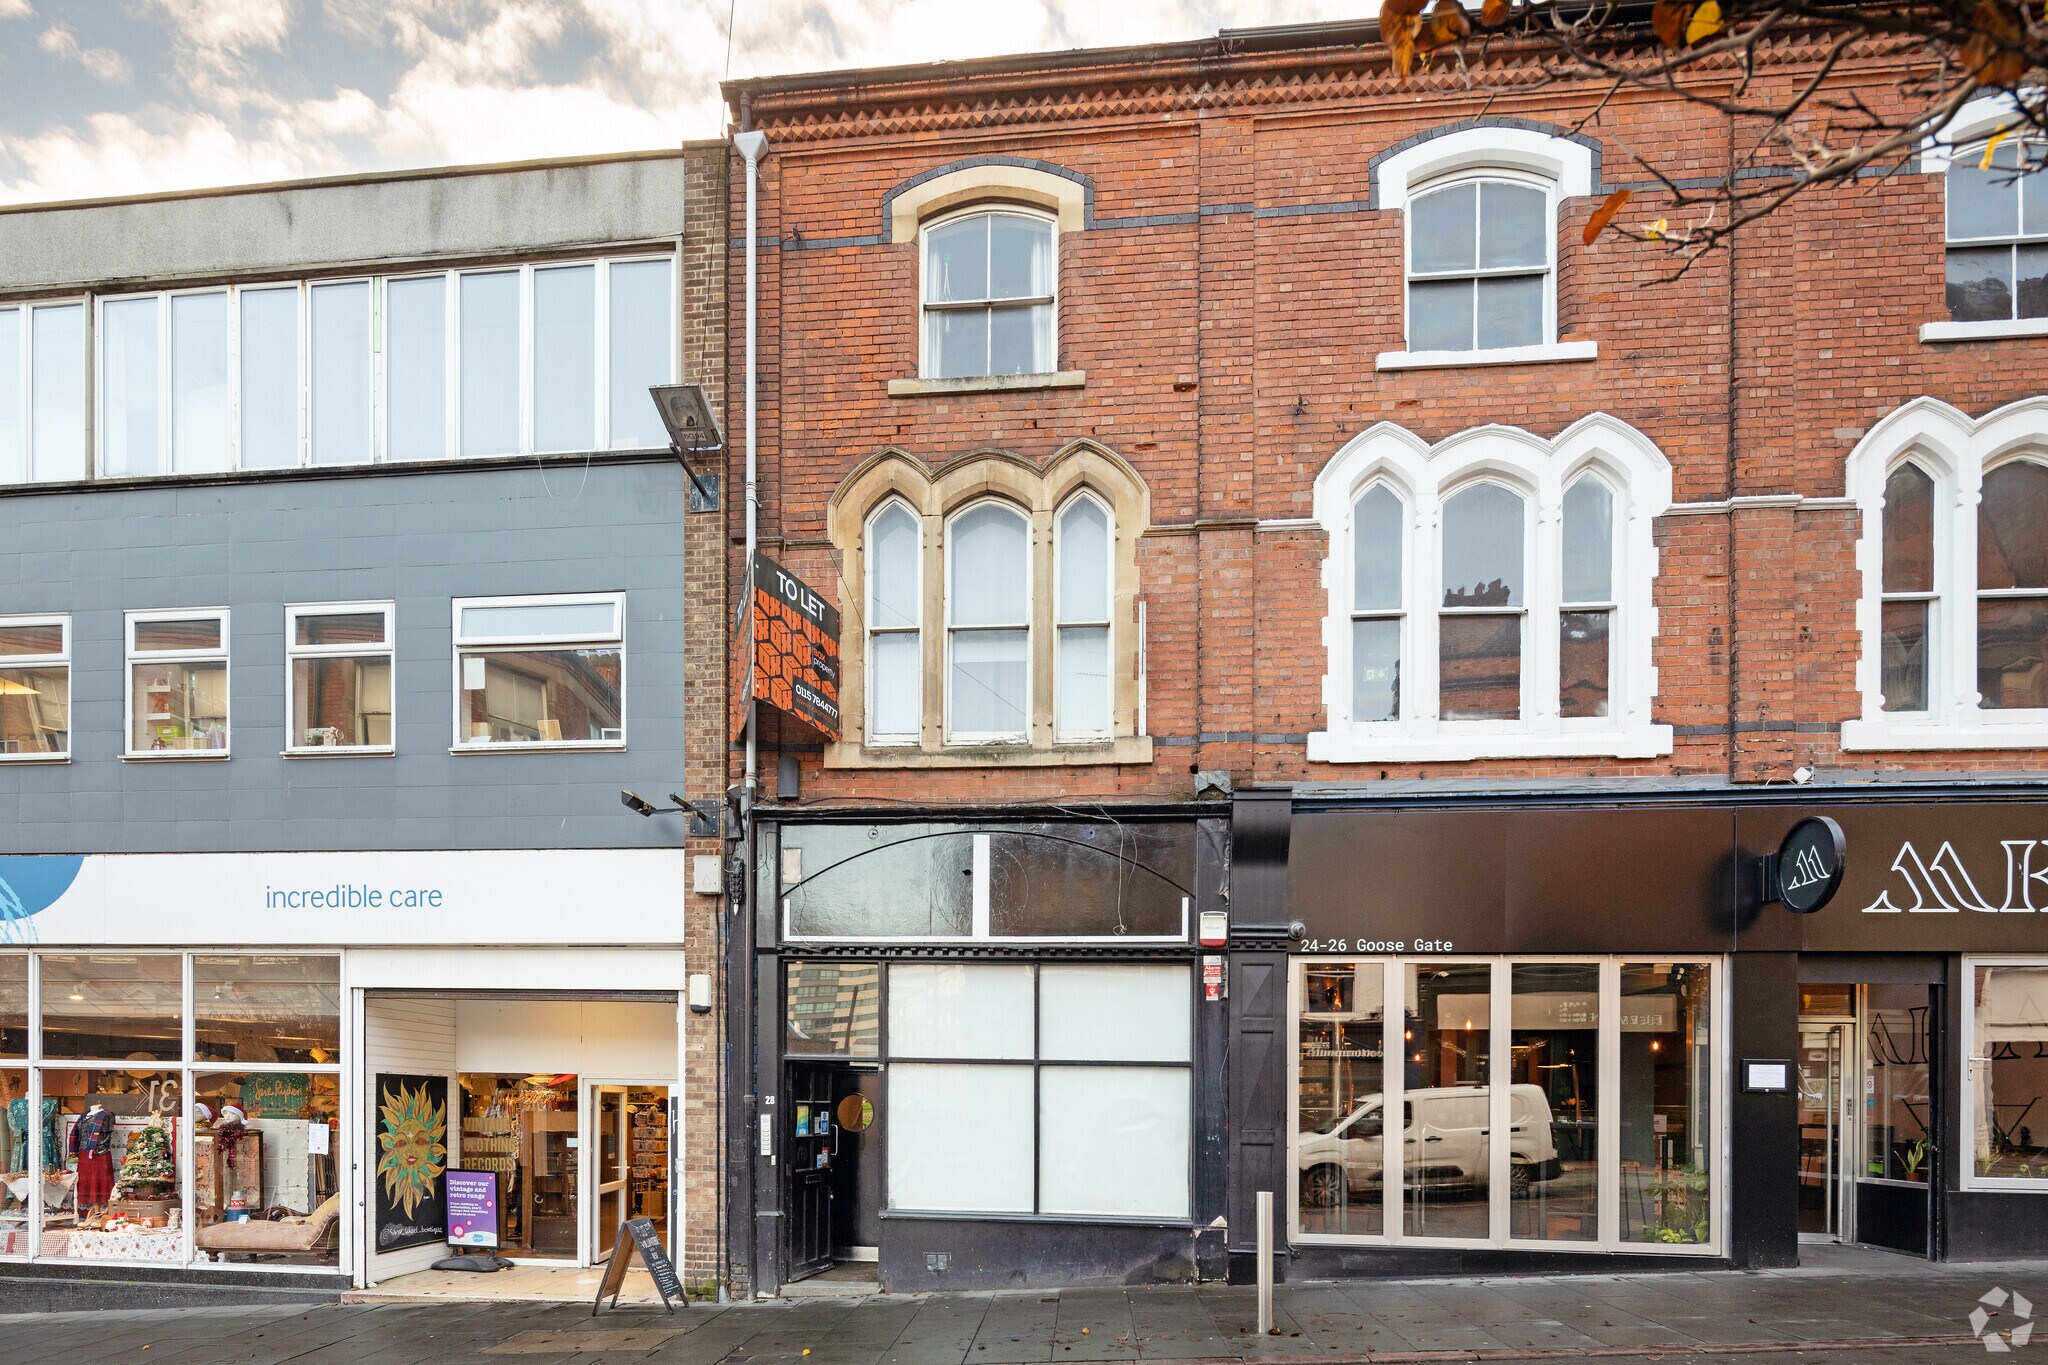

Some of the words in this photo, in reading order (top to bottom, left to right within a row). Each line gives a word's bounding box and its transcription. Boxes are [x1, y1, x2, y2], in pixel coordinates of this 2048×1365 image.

[776, 571, 798, 601] TO
[800, 587, 826, 621] LET
[813, 657, 836, 679] property
[795, 684, 812, 701] 0115
[812, 693, 839, 719] 7844777
[266, 884, 383, 909] incredible
[389, 889, 443, 908] care
[1300, 939, 1347, 952] 24-26
[1356, 938, 1405, 952] Goose
[1413, 938, 1453, 952] Gate
[274, 1079, 300, 1103] Ryder
[765, 1095, 775, 1105] 28
[464, 1117, 511, 1132] VINTAGE
[464, 1138, 516, 1152] CLOTHING
[464, 1157, 514, 1171] RECORDS
[449, 1179, 477, 1187] Discover
